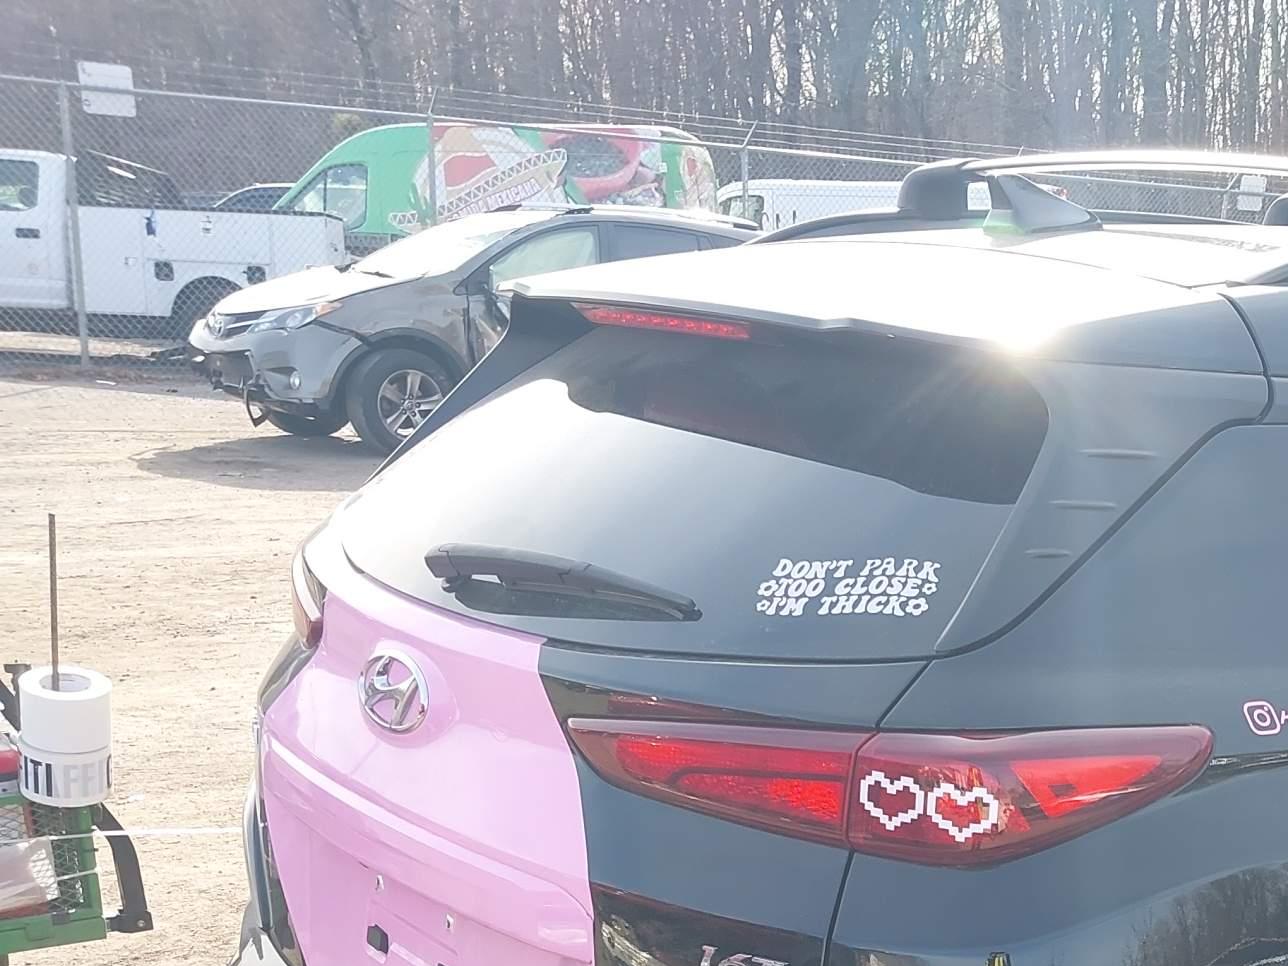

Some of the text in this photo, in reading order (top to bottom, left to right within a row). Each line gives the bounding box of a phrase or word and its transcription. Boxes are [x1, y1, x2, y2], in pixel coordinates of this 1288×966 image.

[772, 557, 941, 582] DON'T PARK
[774, 576, 922, 597] TOO CLOSE
[765, 595, 907, 617] I'M THICK
